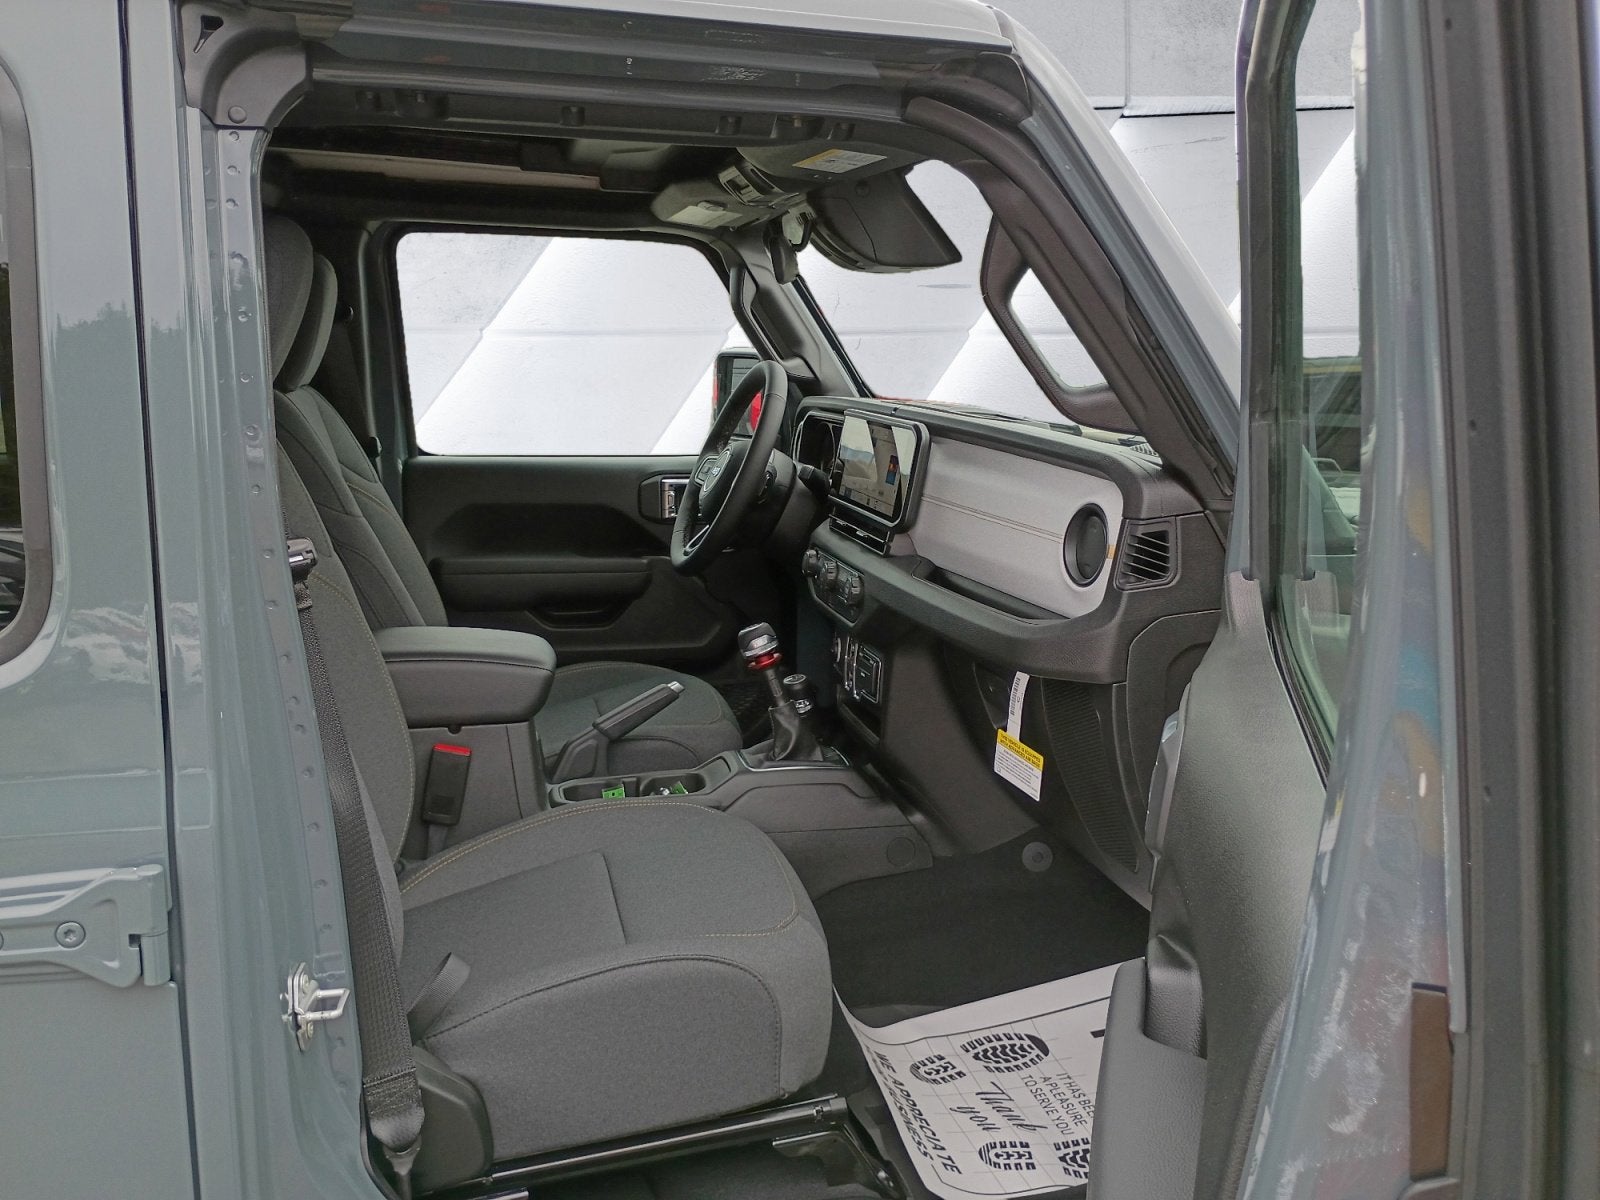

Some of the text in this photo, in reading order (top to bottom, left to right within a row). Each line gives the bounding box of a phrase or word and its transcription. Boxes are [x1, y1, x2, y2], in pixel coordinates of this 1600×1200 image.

[874, 1050, 897, 1073] WE
[888, 1074, 963, 1175] APPRECIATE
[949, 1105, 1001, 1132] you
[975, 1081, 1049, 1134] Thank
[1021, 1074, 1075, 1135] TO SERVE YOU
[1045, 1082, 1088, 1127] PLEASURE
[1056, 1072, 1095, 1118] IT HAS BEE
